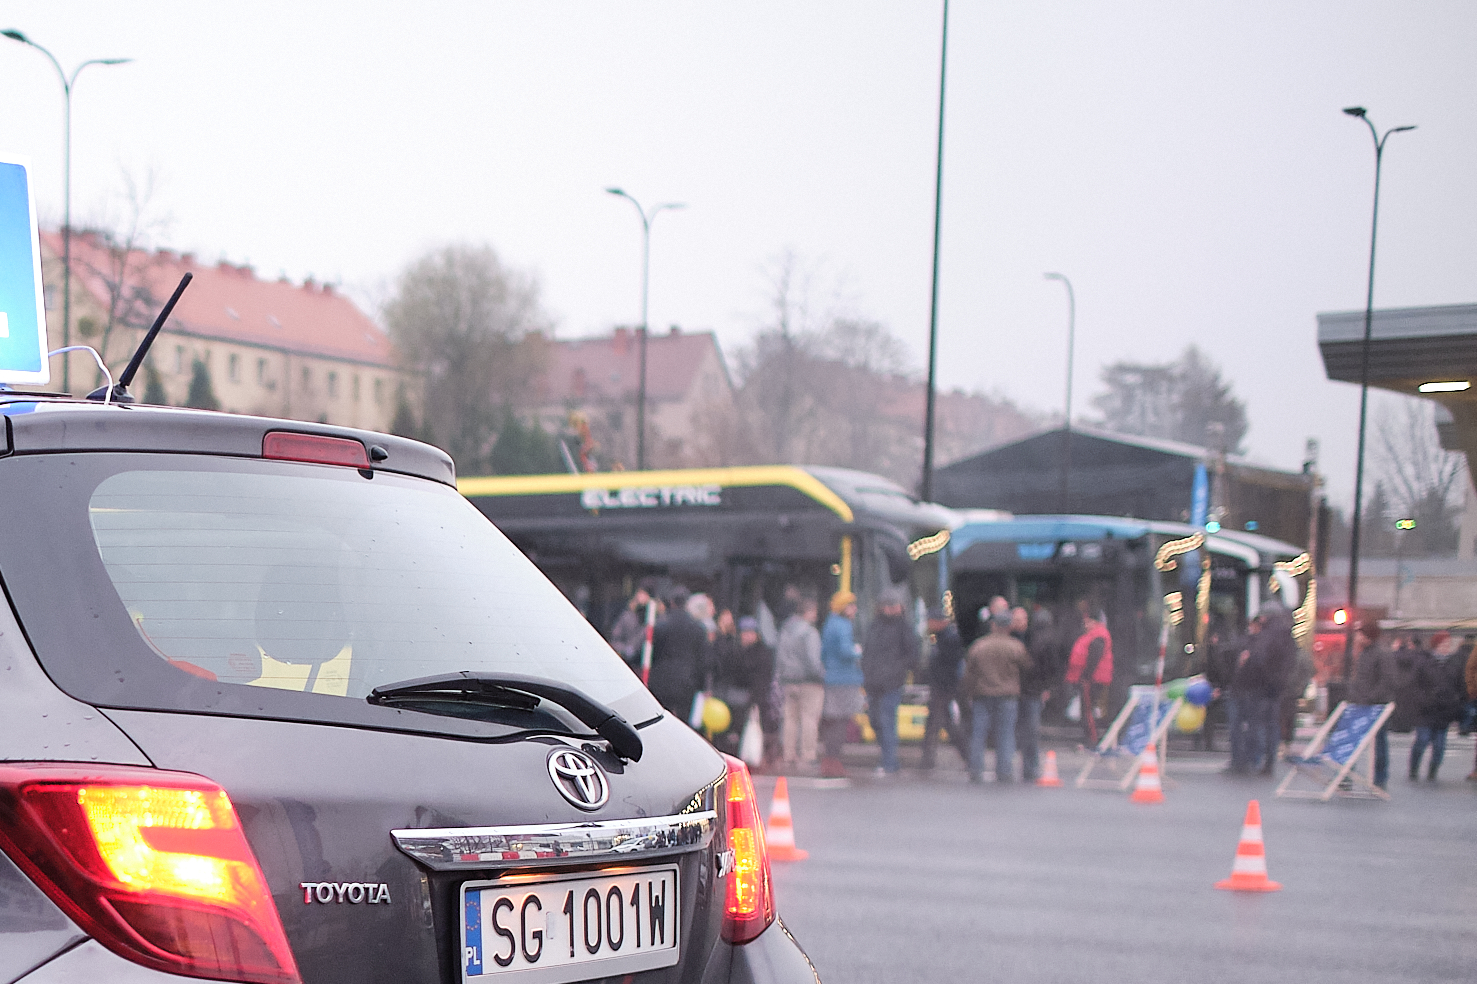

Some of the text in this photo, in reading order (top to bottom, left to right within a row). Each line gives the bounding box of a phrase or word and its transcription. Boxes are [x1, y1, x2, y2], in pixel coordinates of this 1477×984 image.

[580, 485, 722, 509] ELECTRIC
[299, 881, 392, 904] TOYOTA
[491, 878, 667, 967] SG 1001W
[465, 946, 481, 967] PL
